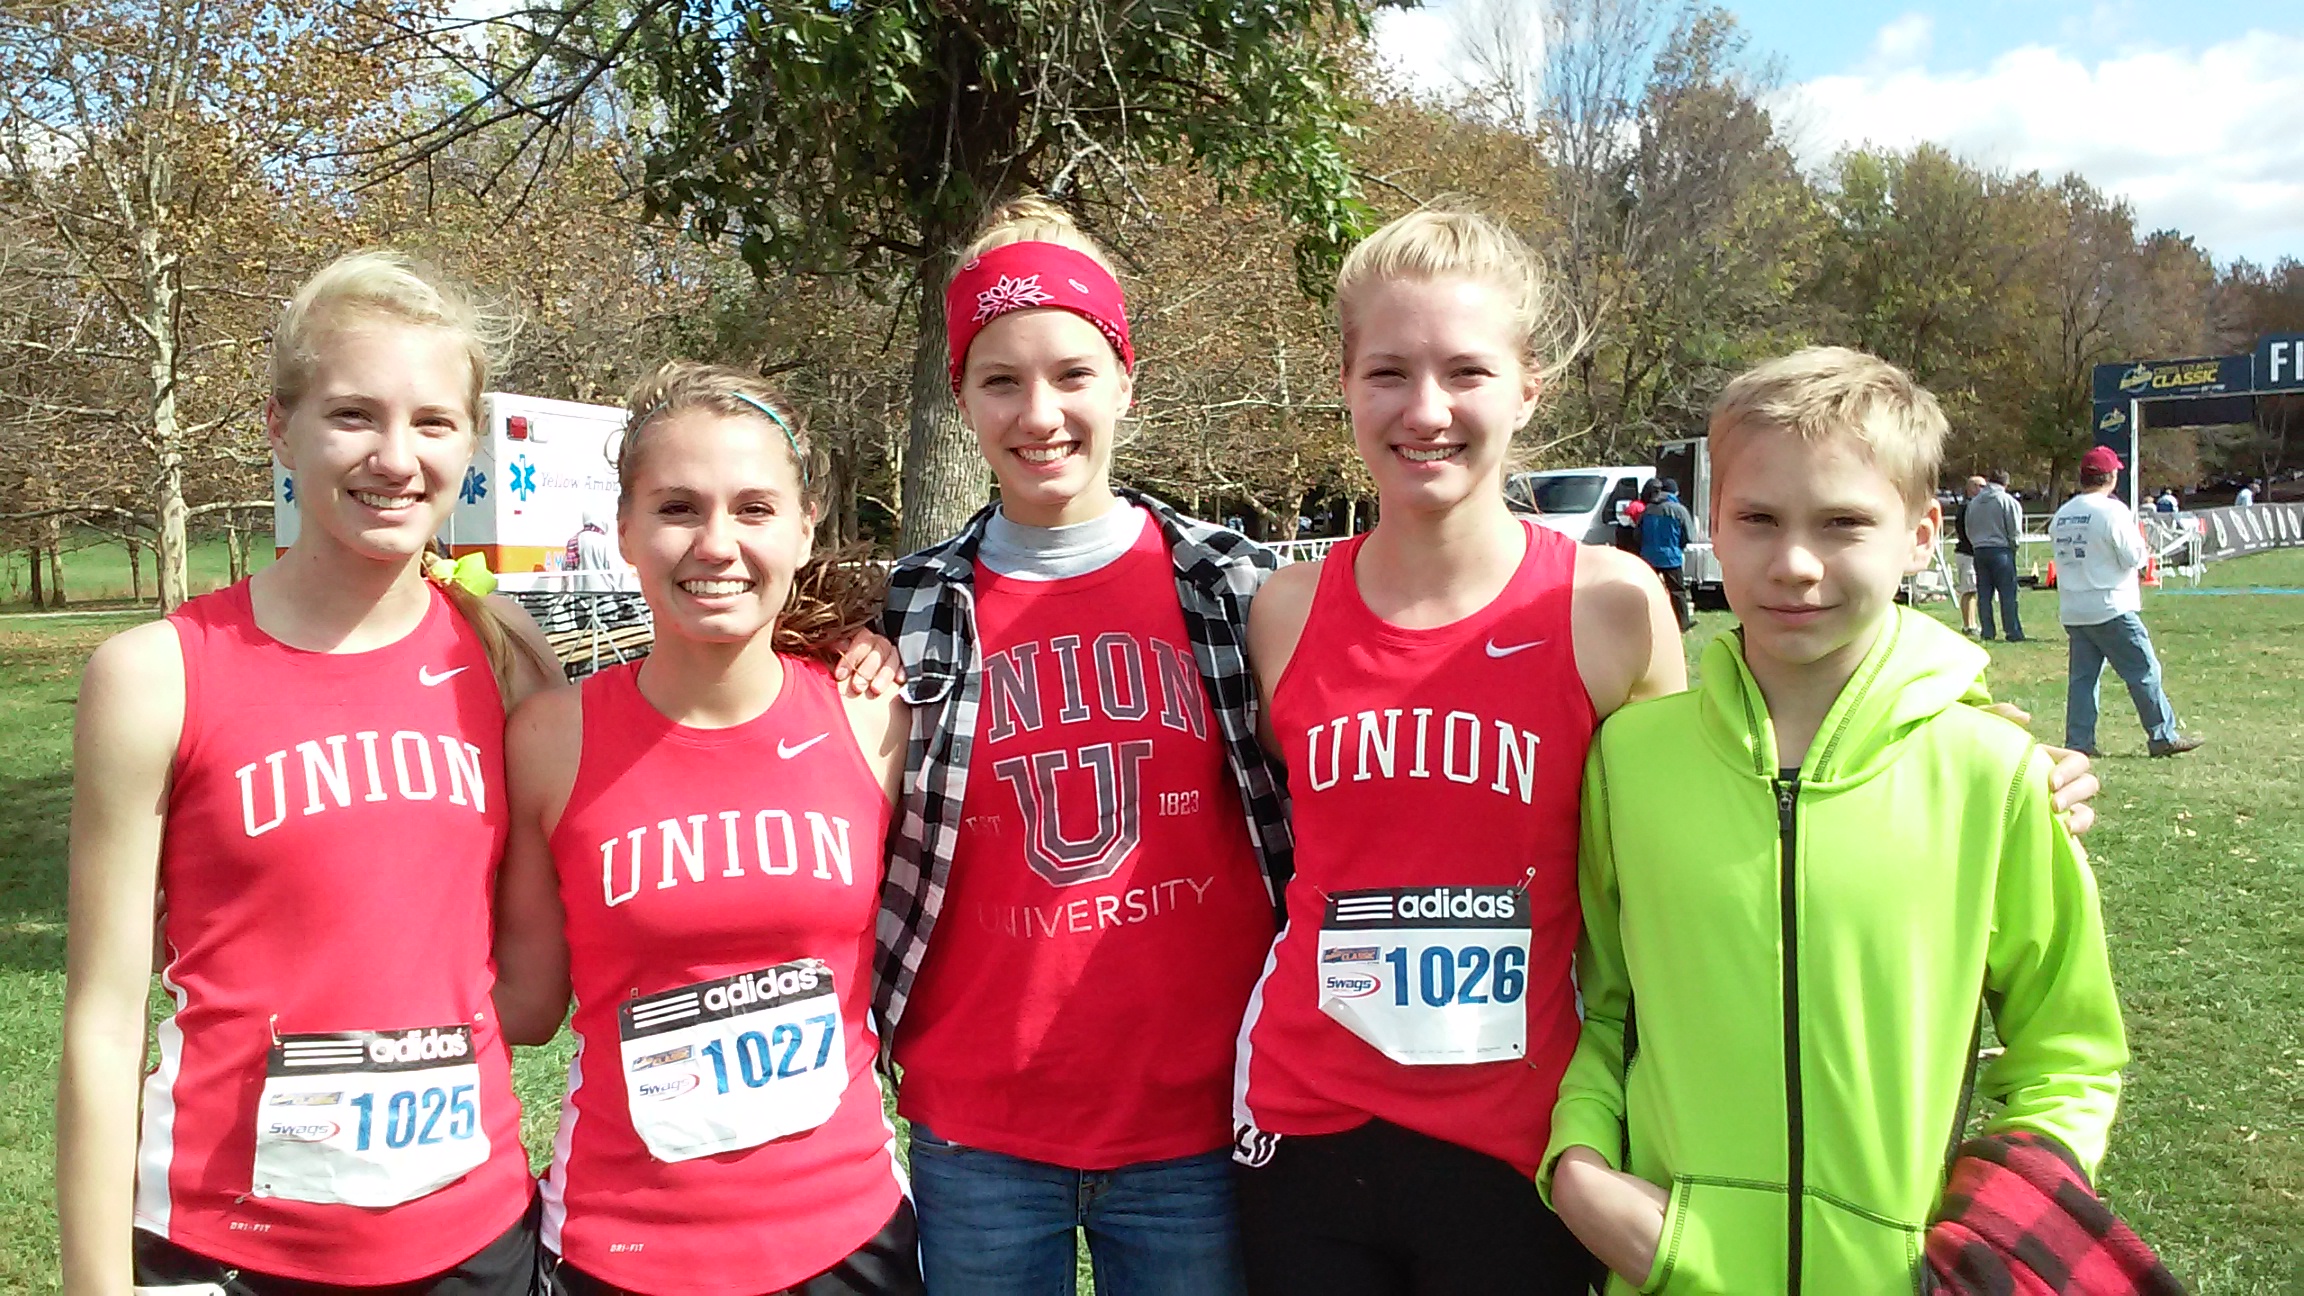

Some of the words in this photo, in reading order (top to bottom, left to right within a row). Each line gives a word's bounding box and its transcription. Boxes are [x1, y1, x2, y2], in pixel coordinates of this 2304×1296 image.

[2152, 370, 2219, 389] CLASSIC
[541, 471, 579, 489] Yellow
[981, 631, 1207, 743] NION
[1307, 708, 1541, 804] UNION
[235, 730, 486, 838] UNION
[1158, 790, 1200, 816] 1823
[993, 739, 1153, 888] U
[600, 809, 853, 908] UNION
[1397, 888, 1515, 919] adidas
[704, 967, 819, 1011] adidas
[1326, 976, 1373, 992] Swags
[1385, 945, 1526, 1008] 1026
[369, 1028, 468, 1063] adidas
[701, 1012, 836, 1095] 1027
[268, 1122, 330, 1137] Swags
[350, 1084, 476, 1152] 1025
[229, 1221, 271, 1232] DRI-FIT
[609, 1243, 645, 1253] DRI-FIT
